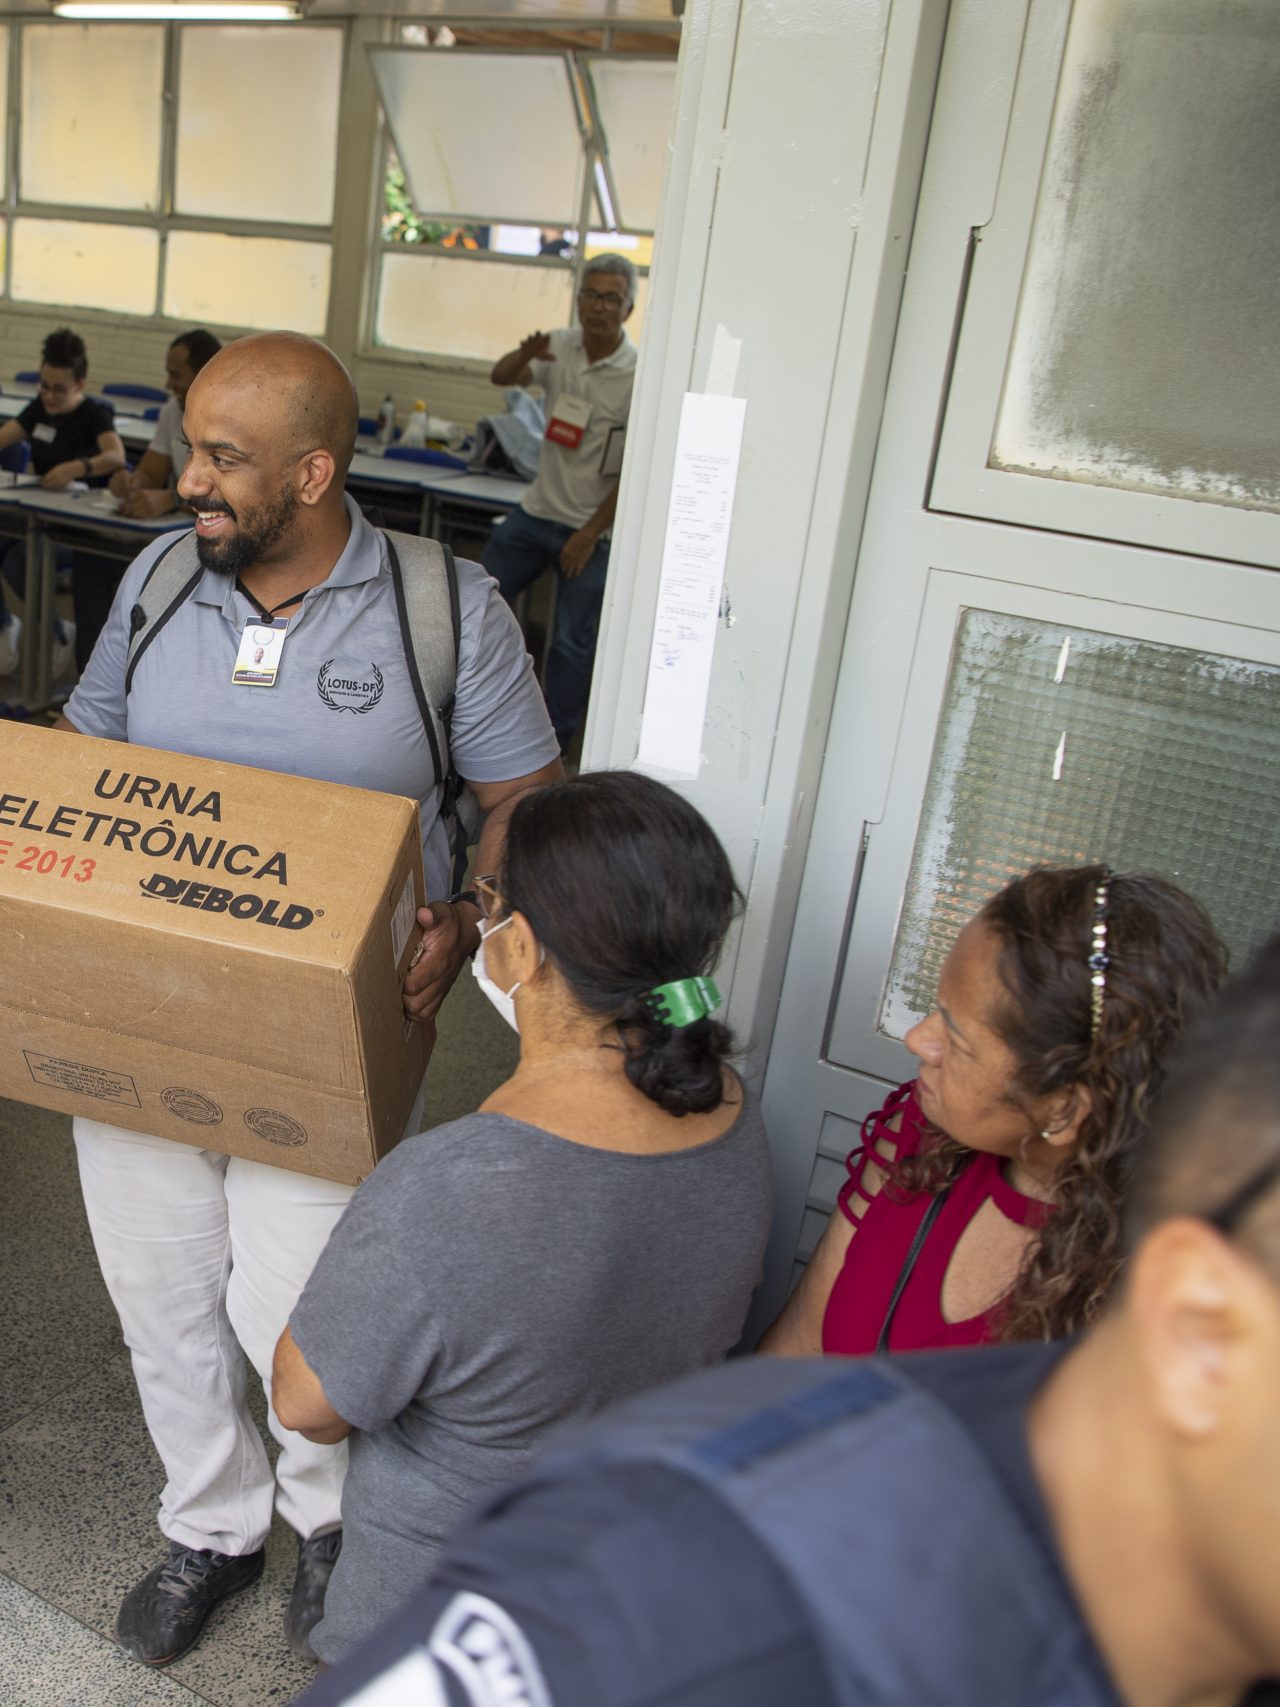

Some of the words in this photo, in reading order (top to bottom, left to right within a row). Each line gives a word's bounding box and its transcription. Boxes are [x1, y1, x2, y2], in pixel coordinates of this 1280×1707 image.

[328, 679, 375, 692] LOTUS-DF
[94, 768, 222, 823] URNA
[15, 845, 97, 883] 2013
[49, 1059, 79, 1070] PAREDE
[81, 1066, 107, 1077] DUPLA
